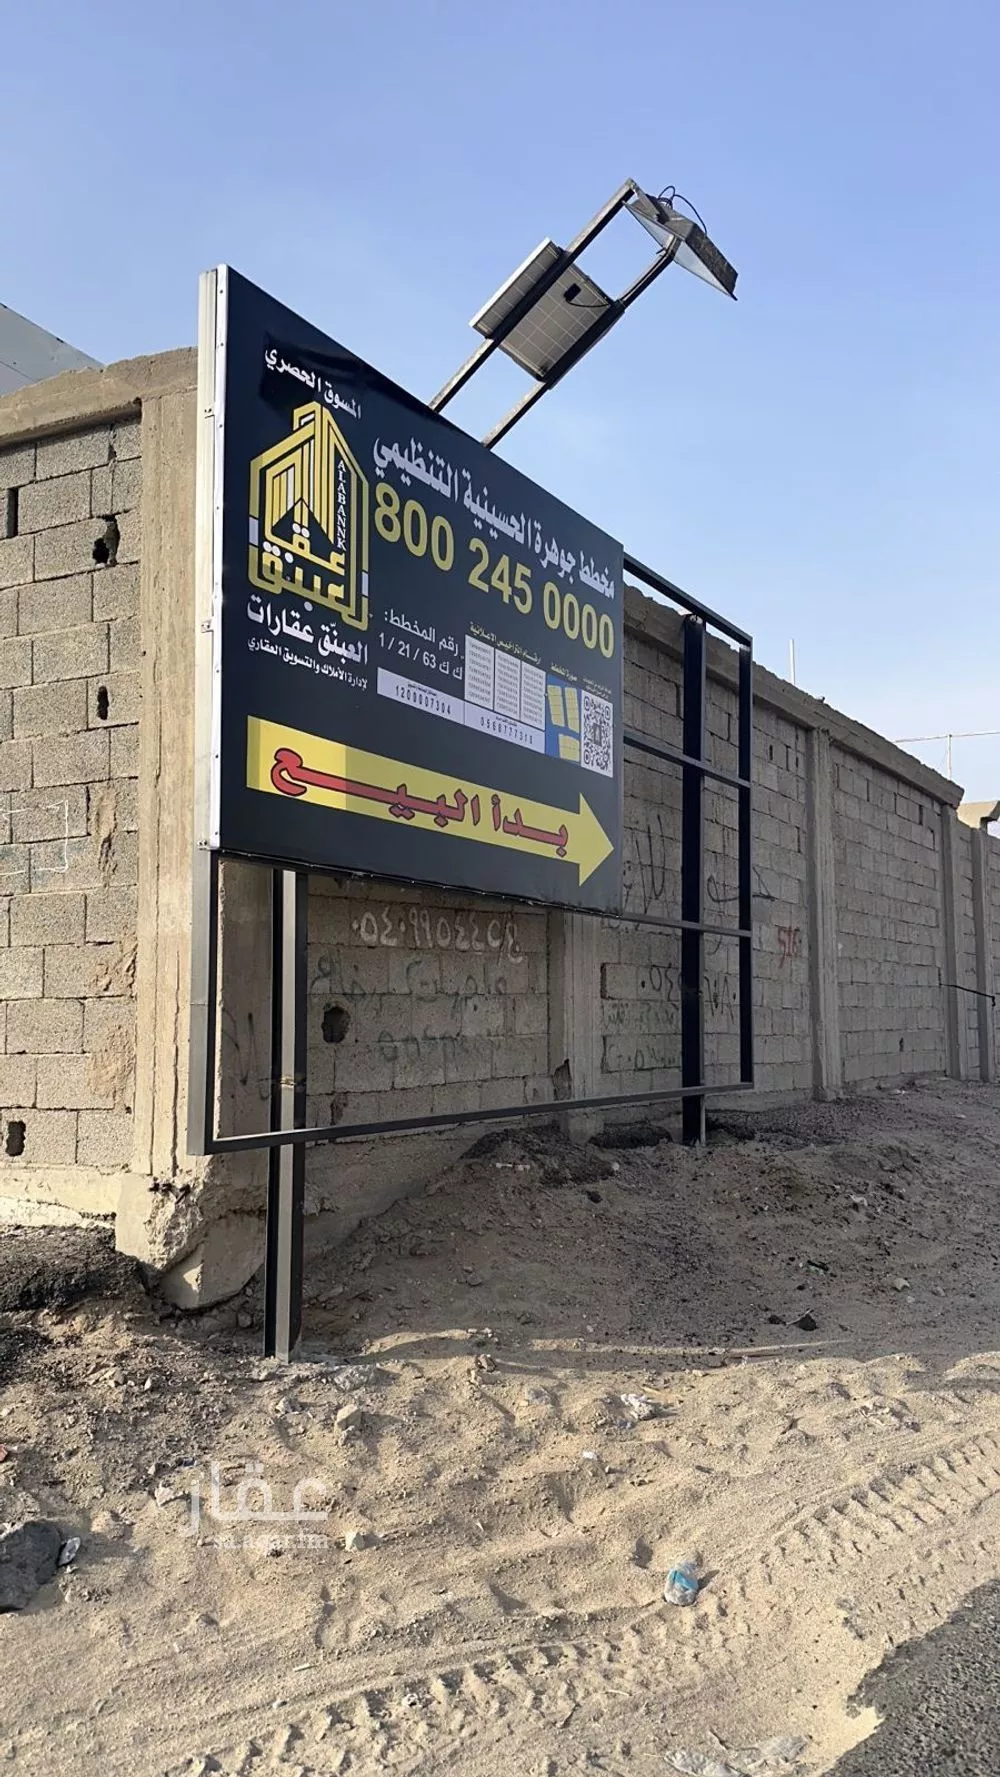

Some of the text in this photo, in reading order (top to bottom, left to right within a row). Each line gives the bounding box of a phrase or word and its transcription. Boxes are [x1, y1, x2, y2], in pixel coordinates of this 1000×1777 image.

[264, 349, 361, 419] المسوق الحصري
[373, 437, 615, 600] مخطط جوهرة الحسينية التنظيمي
[374, 481, 615, 659] 800 245 0000
[247, 593, 315, 644] عقارات
[247, 637, 282, 656] العقاري
[398, 640, 410, 658] 21
[422, 651, 437, 669] 63
[439, 636, 459, 657] رقم
[491, 794, 568, 857] بدأ
